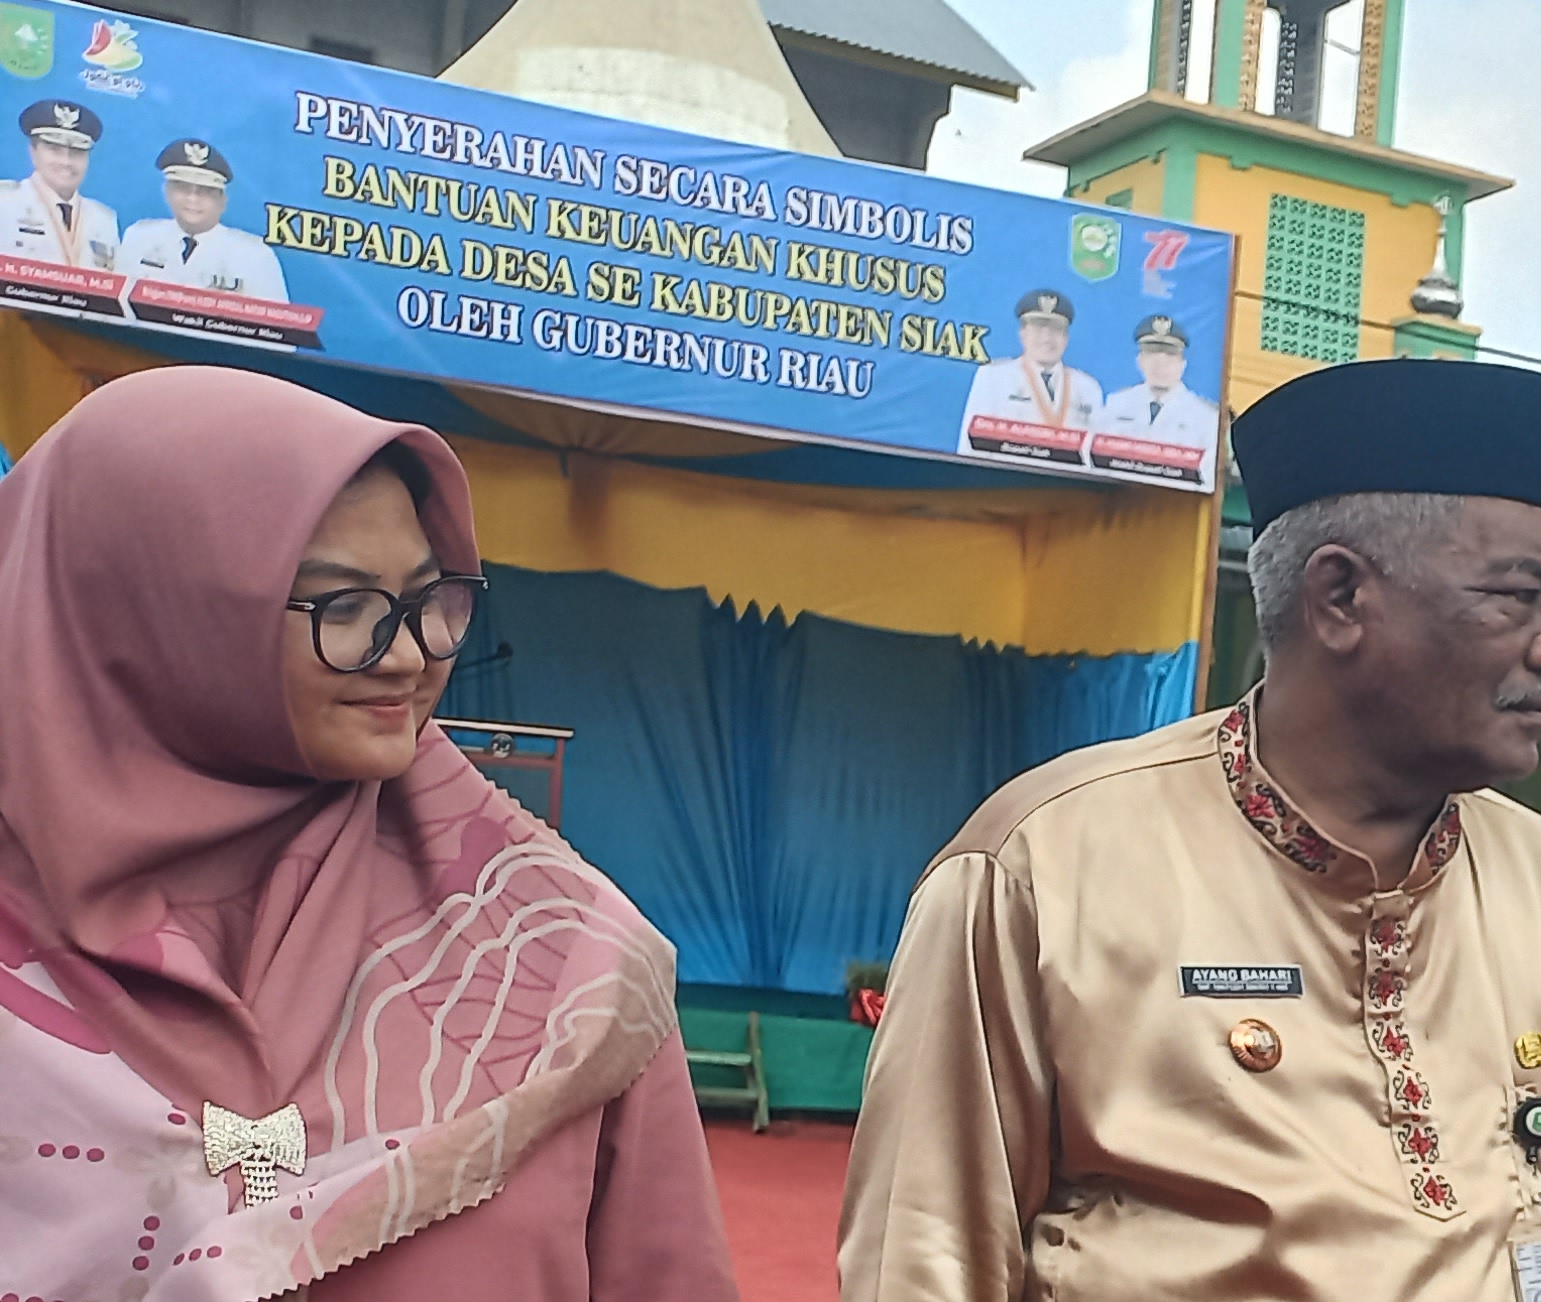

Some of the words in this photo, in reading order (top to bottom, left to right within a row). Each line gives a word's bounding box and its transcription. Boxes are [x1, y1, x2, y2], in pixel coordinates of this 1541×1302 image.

[295, 91, 606, 189] PENYERAHAN
[614, 154, 777, 221] SECARA
[785, 187, 974, 255] SIMBOLIS
[324, 156, 537, 233] BANTUAN
[547, 199, 779, 276] KEUANGAN
[787, 241, 947, 304] KHUSUS
[265, 204, 451, 276] KEPADA
[461, 239, 577, 297] DESA
[587, 262, 642, 307] SE
[651, 272, 892, 348] KABUPATEN
[901, 314, 991, 364] SIAK
[397, 286, 524, 344] OLEH
[532, 308, 770, 385] GUBERNUR
[779, 349, 875, 398] RIAU
[1240, 969, 1291, 981] BAHARI
